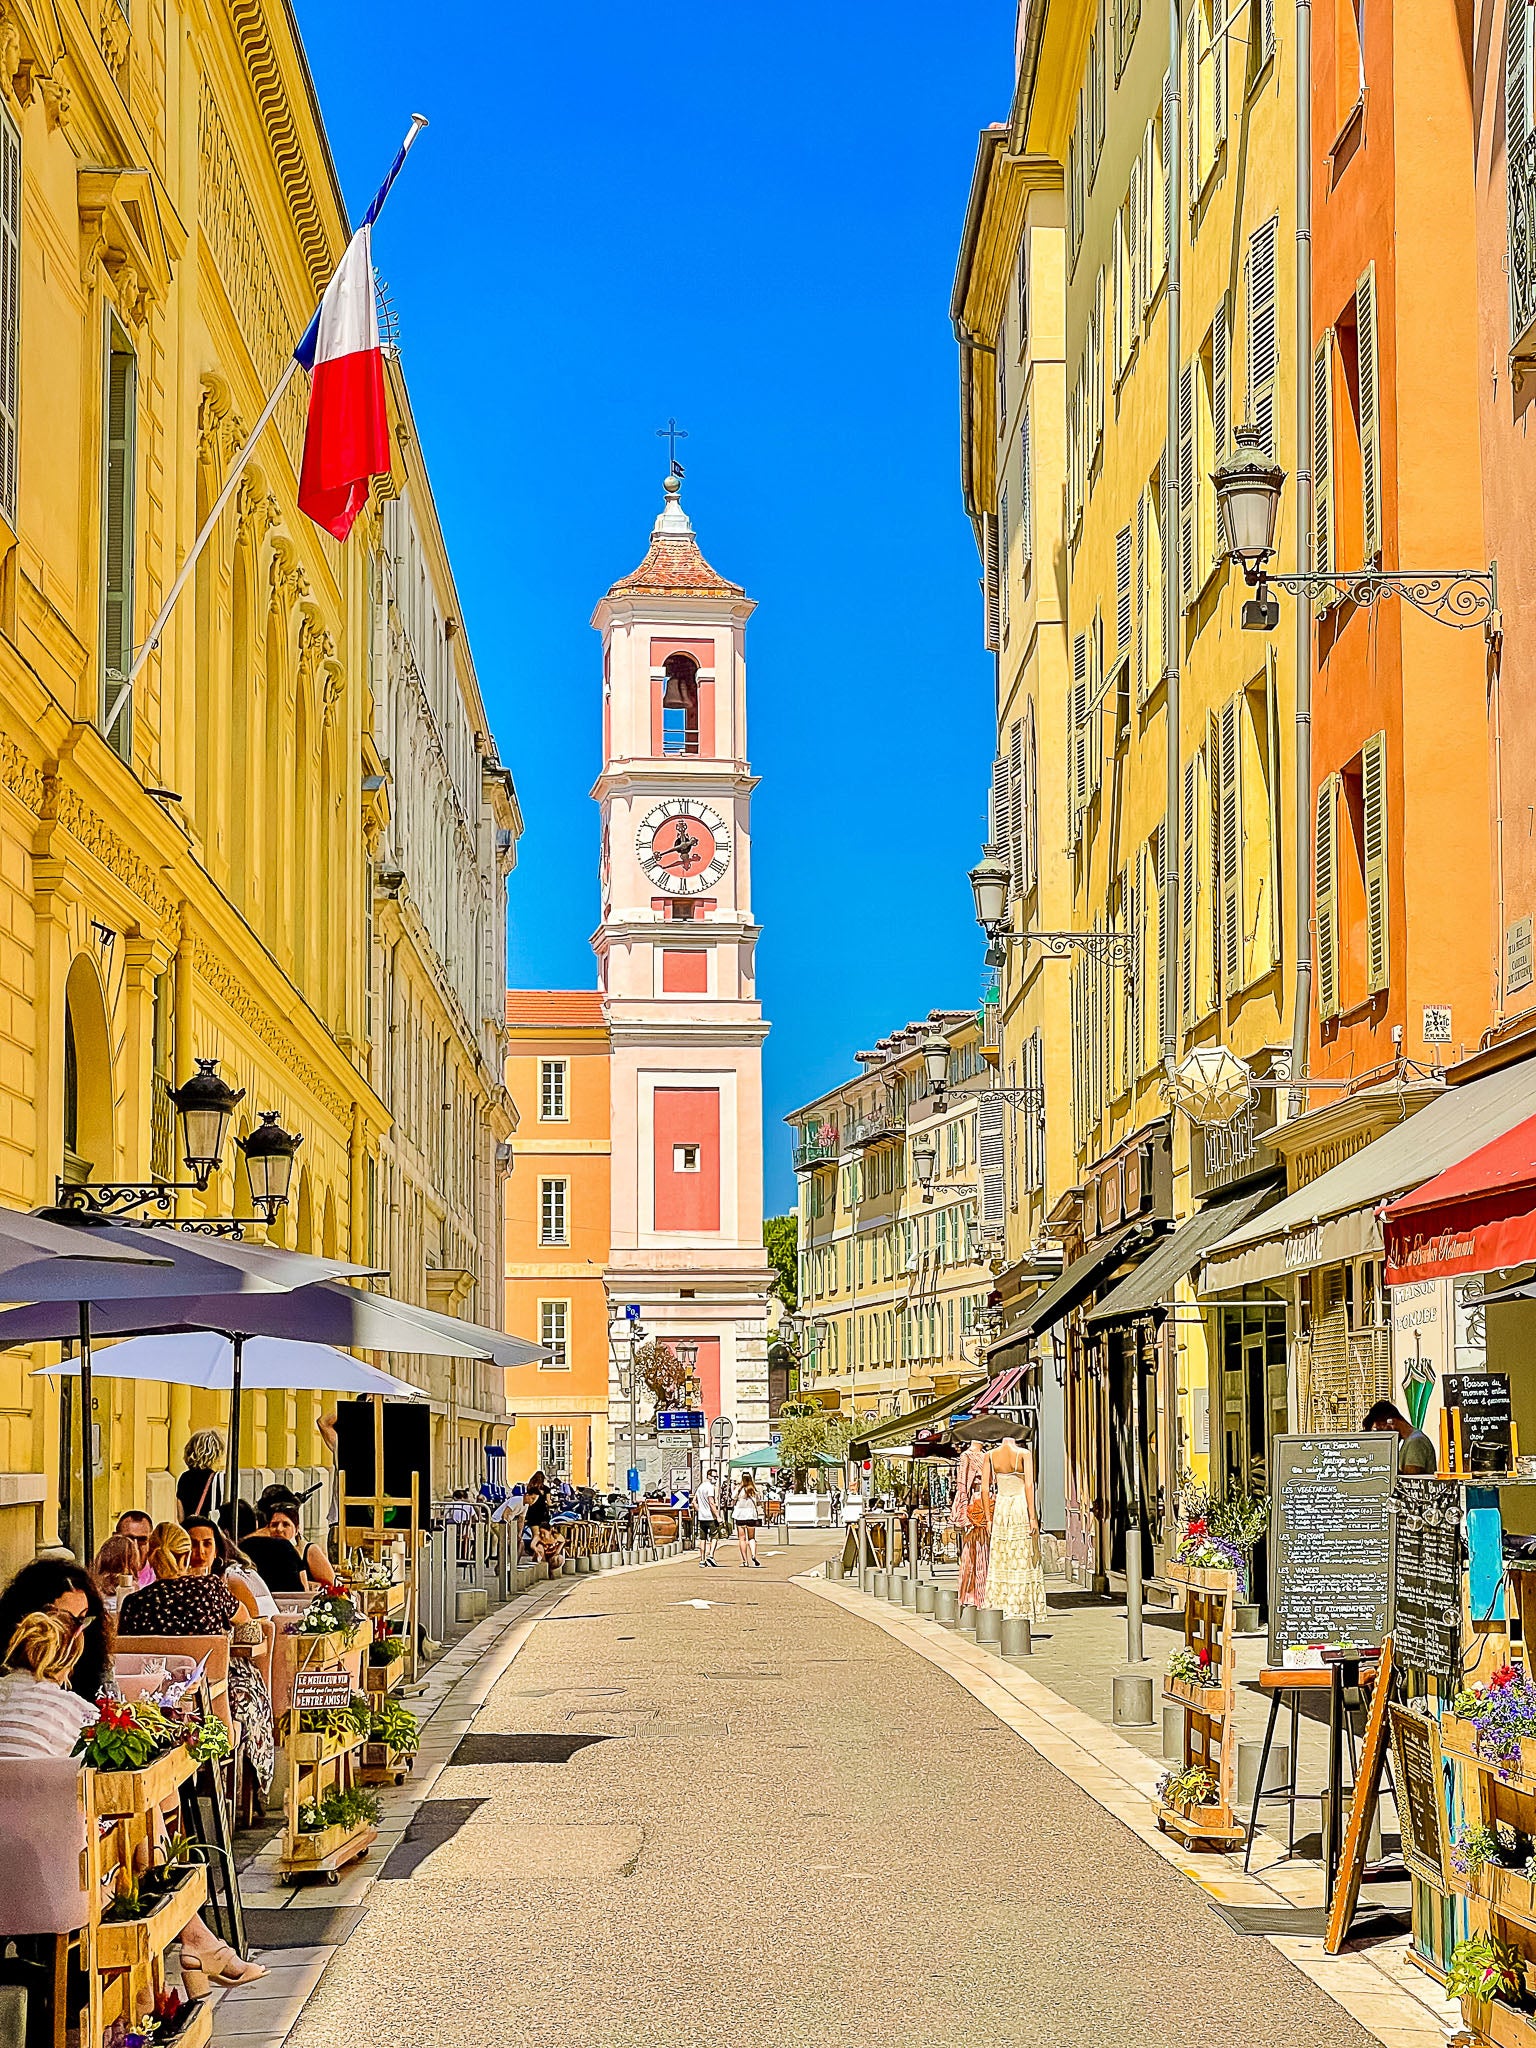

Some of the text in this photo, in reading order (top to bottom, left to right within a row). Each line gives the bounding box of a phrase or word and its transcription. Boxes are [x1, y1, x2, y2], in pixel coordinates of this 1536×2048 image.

[1395, 1281, 1436, 1305] MAISON
[299, 1674, 348, 1685] LE MEILLEUR VIN
[301, 1695, 324, 1706] ENTRE
